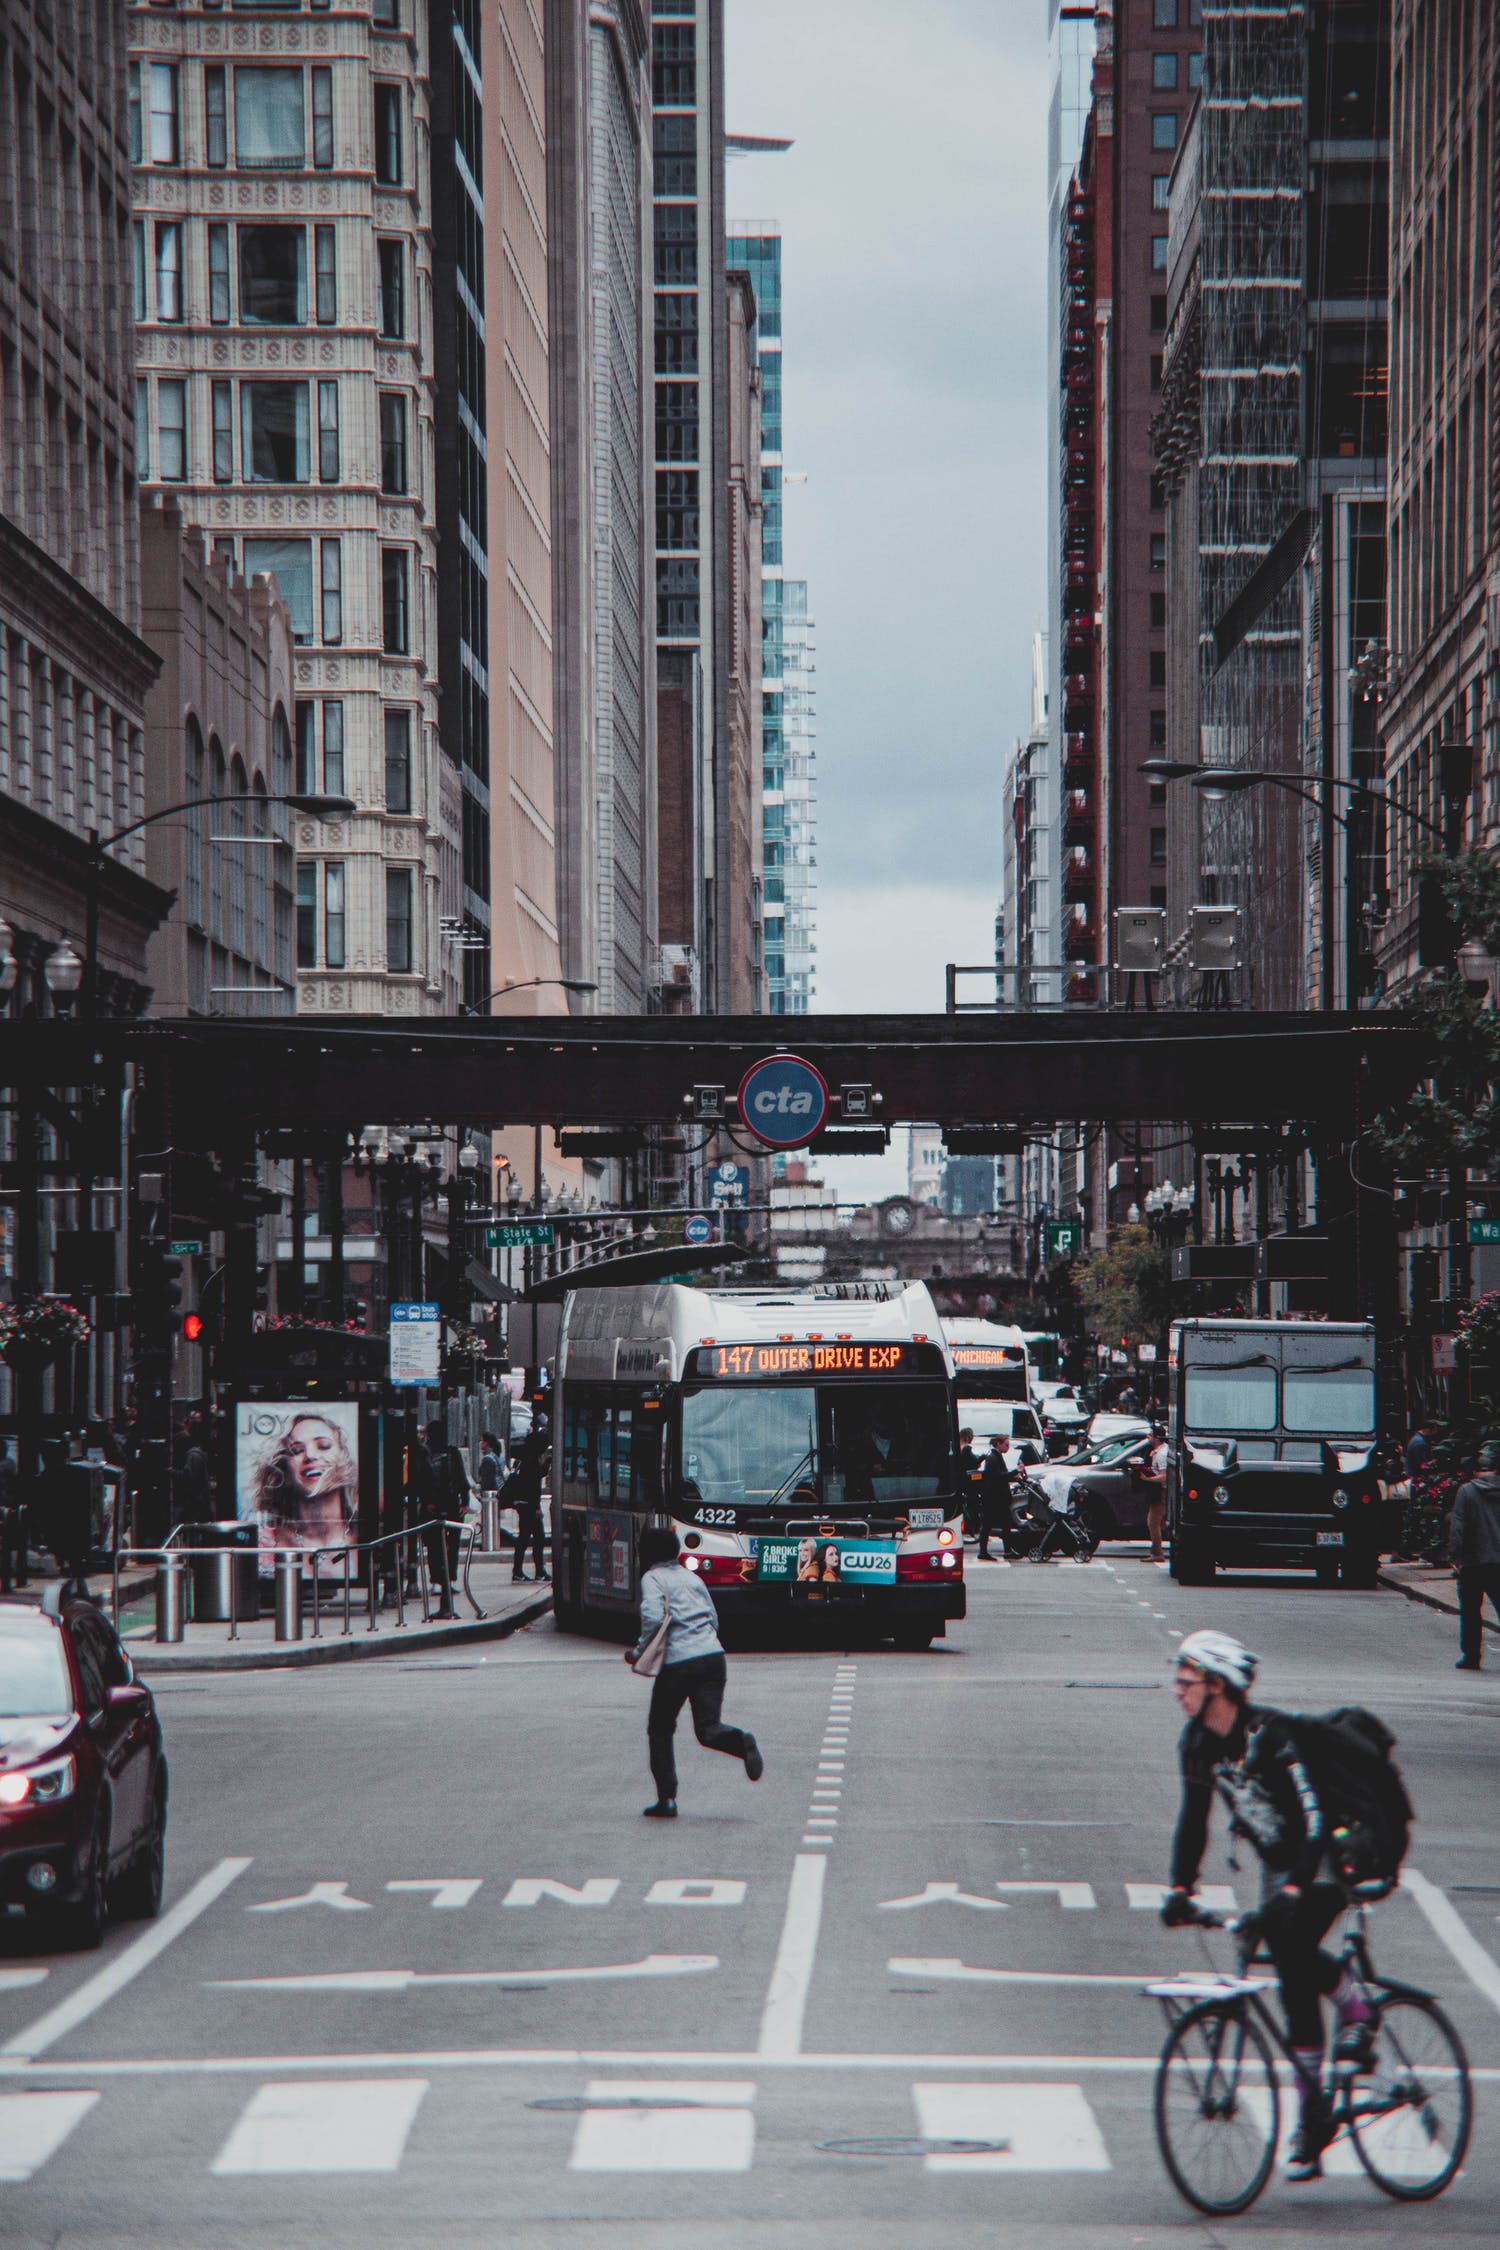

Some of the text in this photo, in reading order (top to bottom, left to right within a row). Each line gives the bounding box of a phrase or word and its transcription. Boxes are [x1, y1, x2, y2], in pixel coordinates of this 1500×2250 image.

[755, 1086, 813, 1114] cta
[490, 1226, 549, 1238] N State St
[421, 1313, 438, 1321] stop
[717, 1346, 901, 1375] 147 OUTER DRIVE EXP
[241, 1414, 290, 1435] JOY
[694, 1508, 736, 1525] 4322
[763, 1545, 798, 1556] 2 BROKE
[763, 1554, 787, 1565] GIRLS
[244, 1878, 748, 1912] ONLY
[876, 1881, 1238, 1910] NLY
